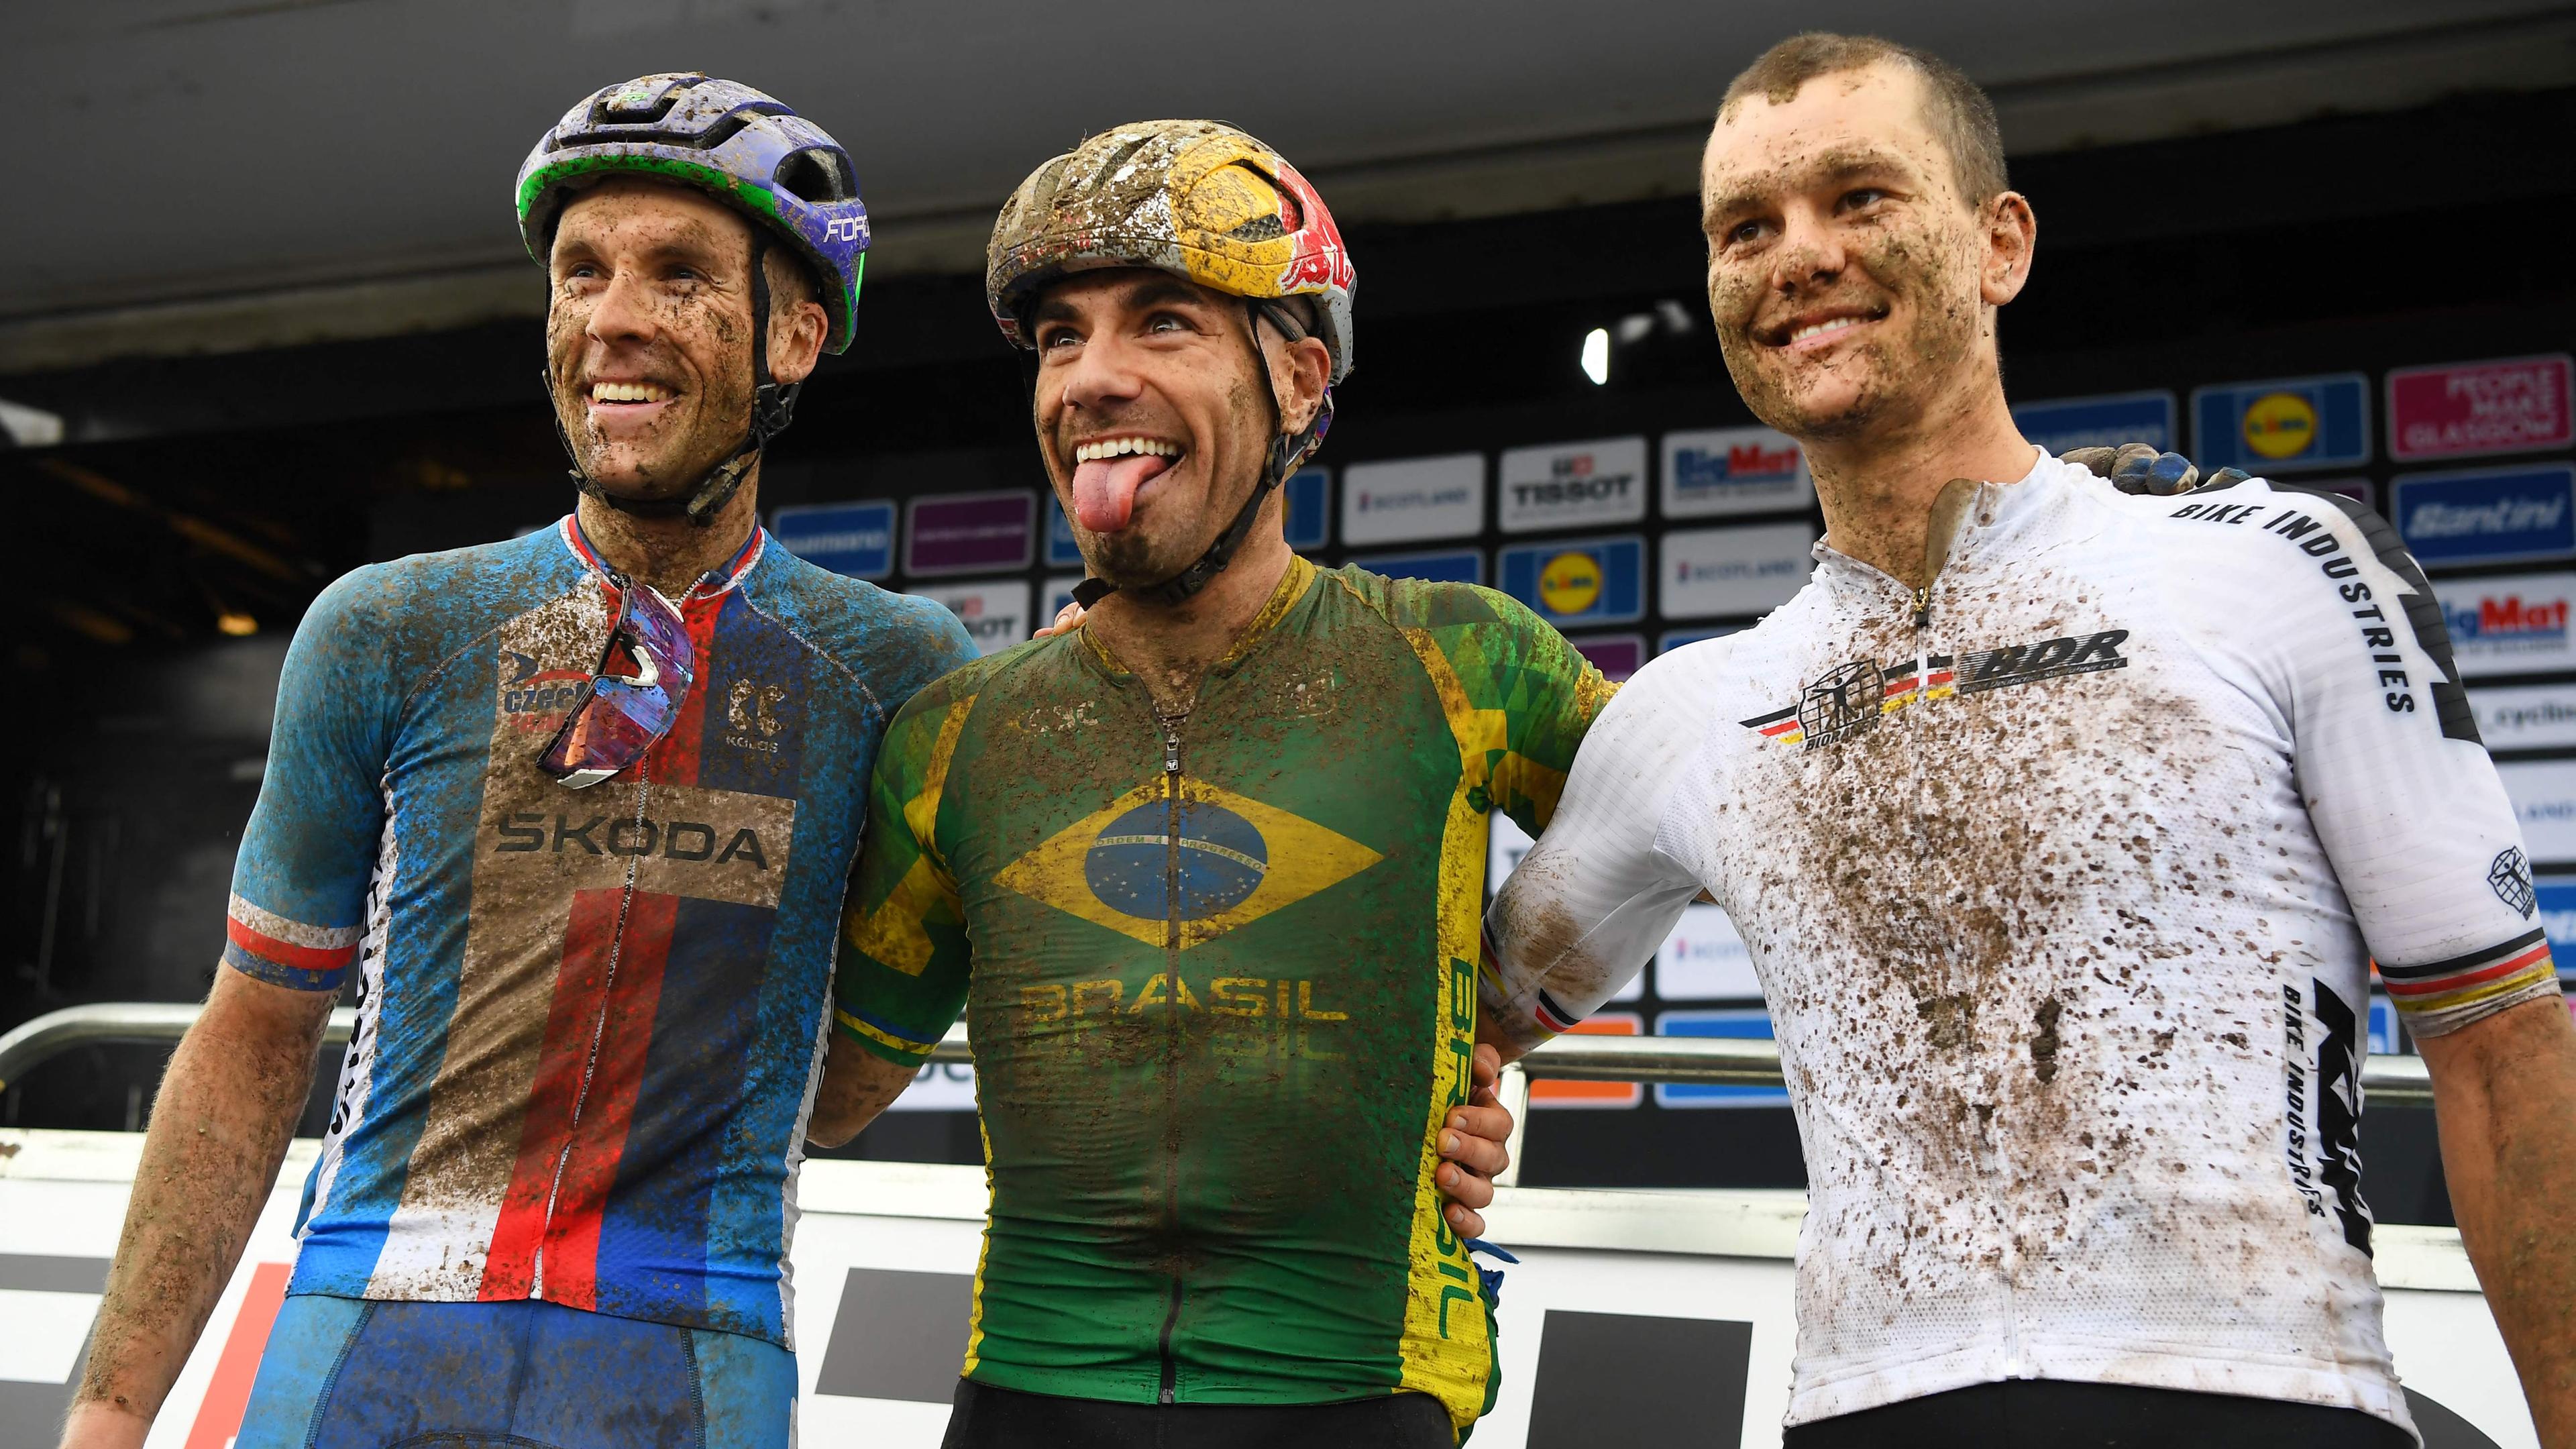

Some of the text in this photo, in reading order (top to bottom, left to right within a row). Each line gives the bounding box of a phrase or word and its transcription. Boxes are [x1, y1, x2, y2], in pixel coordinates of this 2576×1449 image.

[1511, 472, 1633, 506] TISSOT
[2168, 504, 2415, 714] BIKE INDUSTRIES
[1096, 836, 1145, 847] ORDEM
[1020, 973, 1350, 1022] BRASIL
[2283, 983, 2326, 1218] BIKE INDUSTRIES
